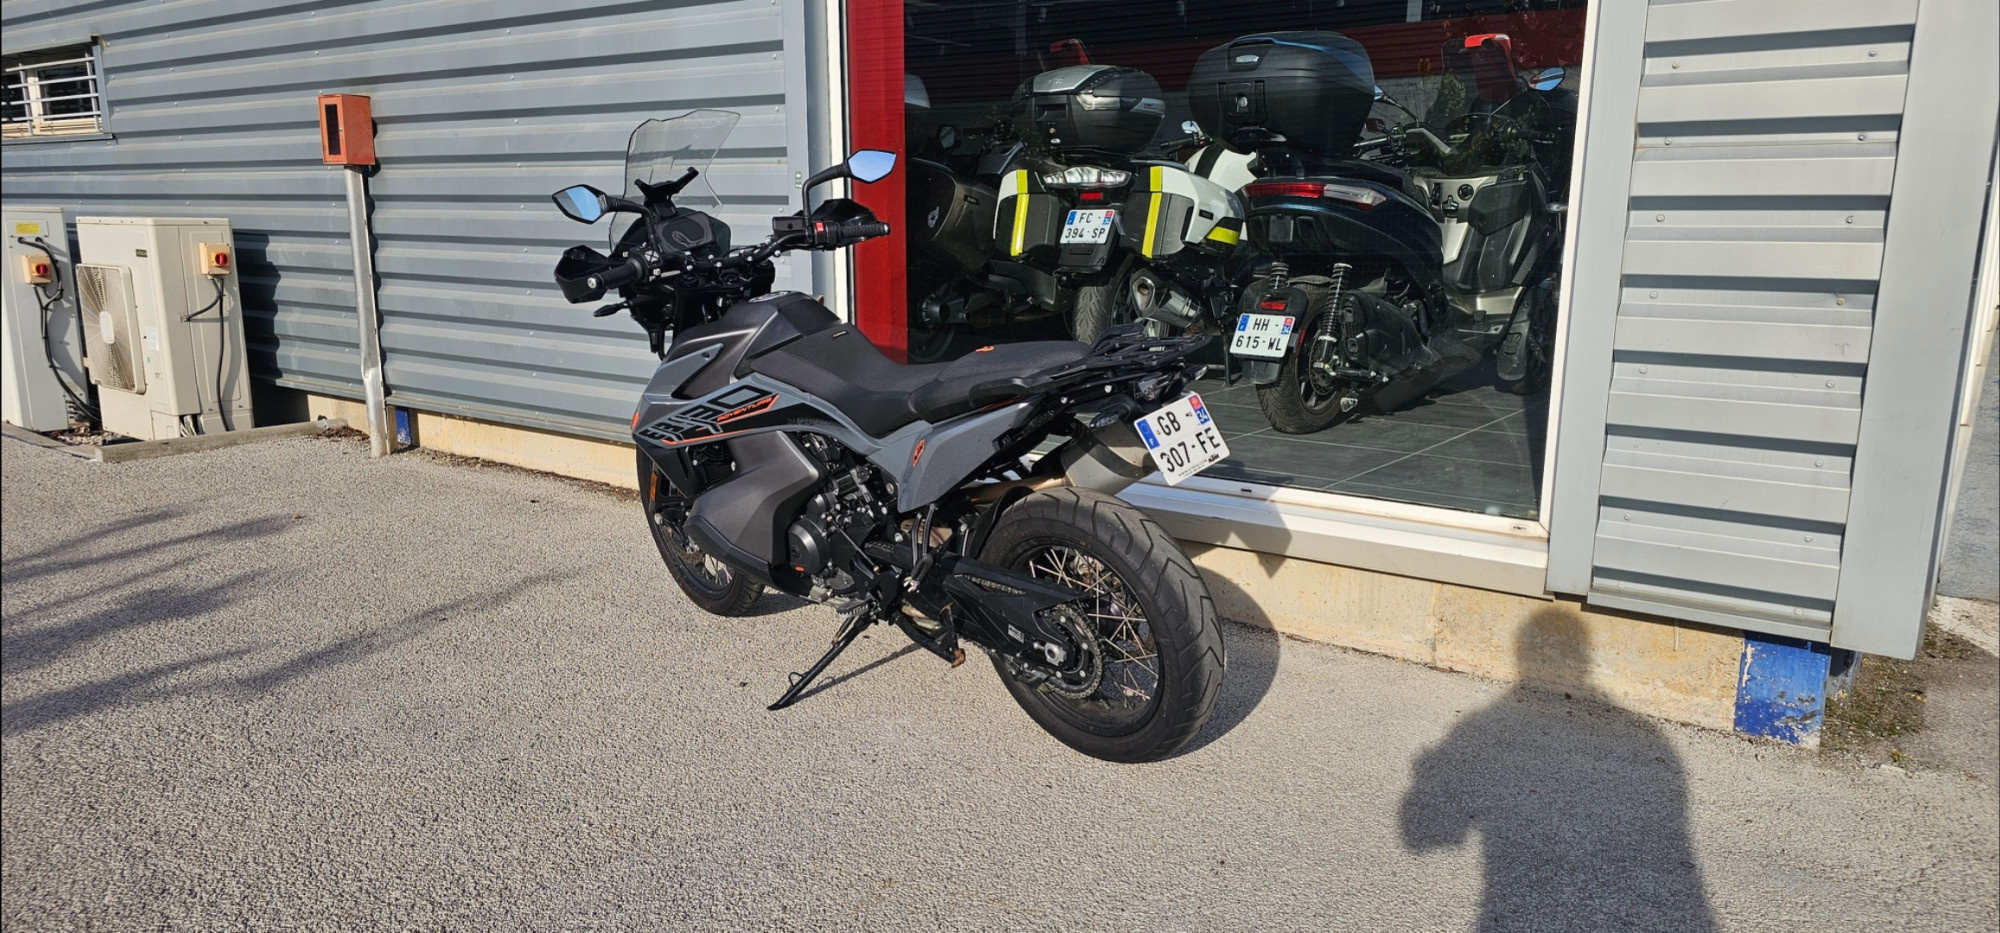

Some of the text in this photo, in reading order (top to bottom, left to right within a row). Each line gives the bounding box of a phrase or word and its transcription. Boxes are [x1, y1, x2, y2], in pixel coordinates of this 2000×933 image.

[1078, 213, 1093, 224] FC
[1252, 318, 1271, 331] HH
[717, 396, 773, 422] ADVENTURE
[1196, 408, 1208, 422] 34
[1157, 411, 1181, 436] GB
